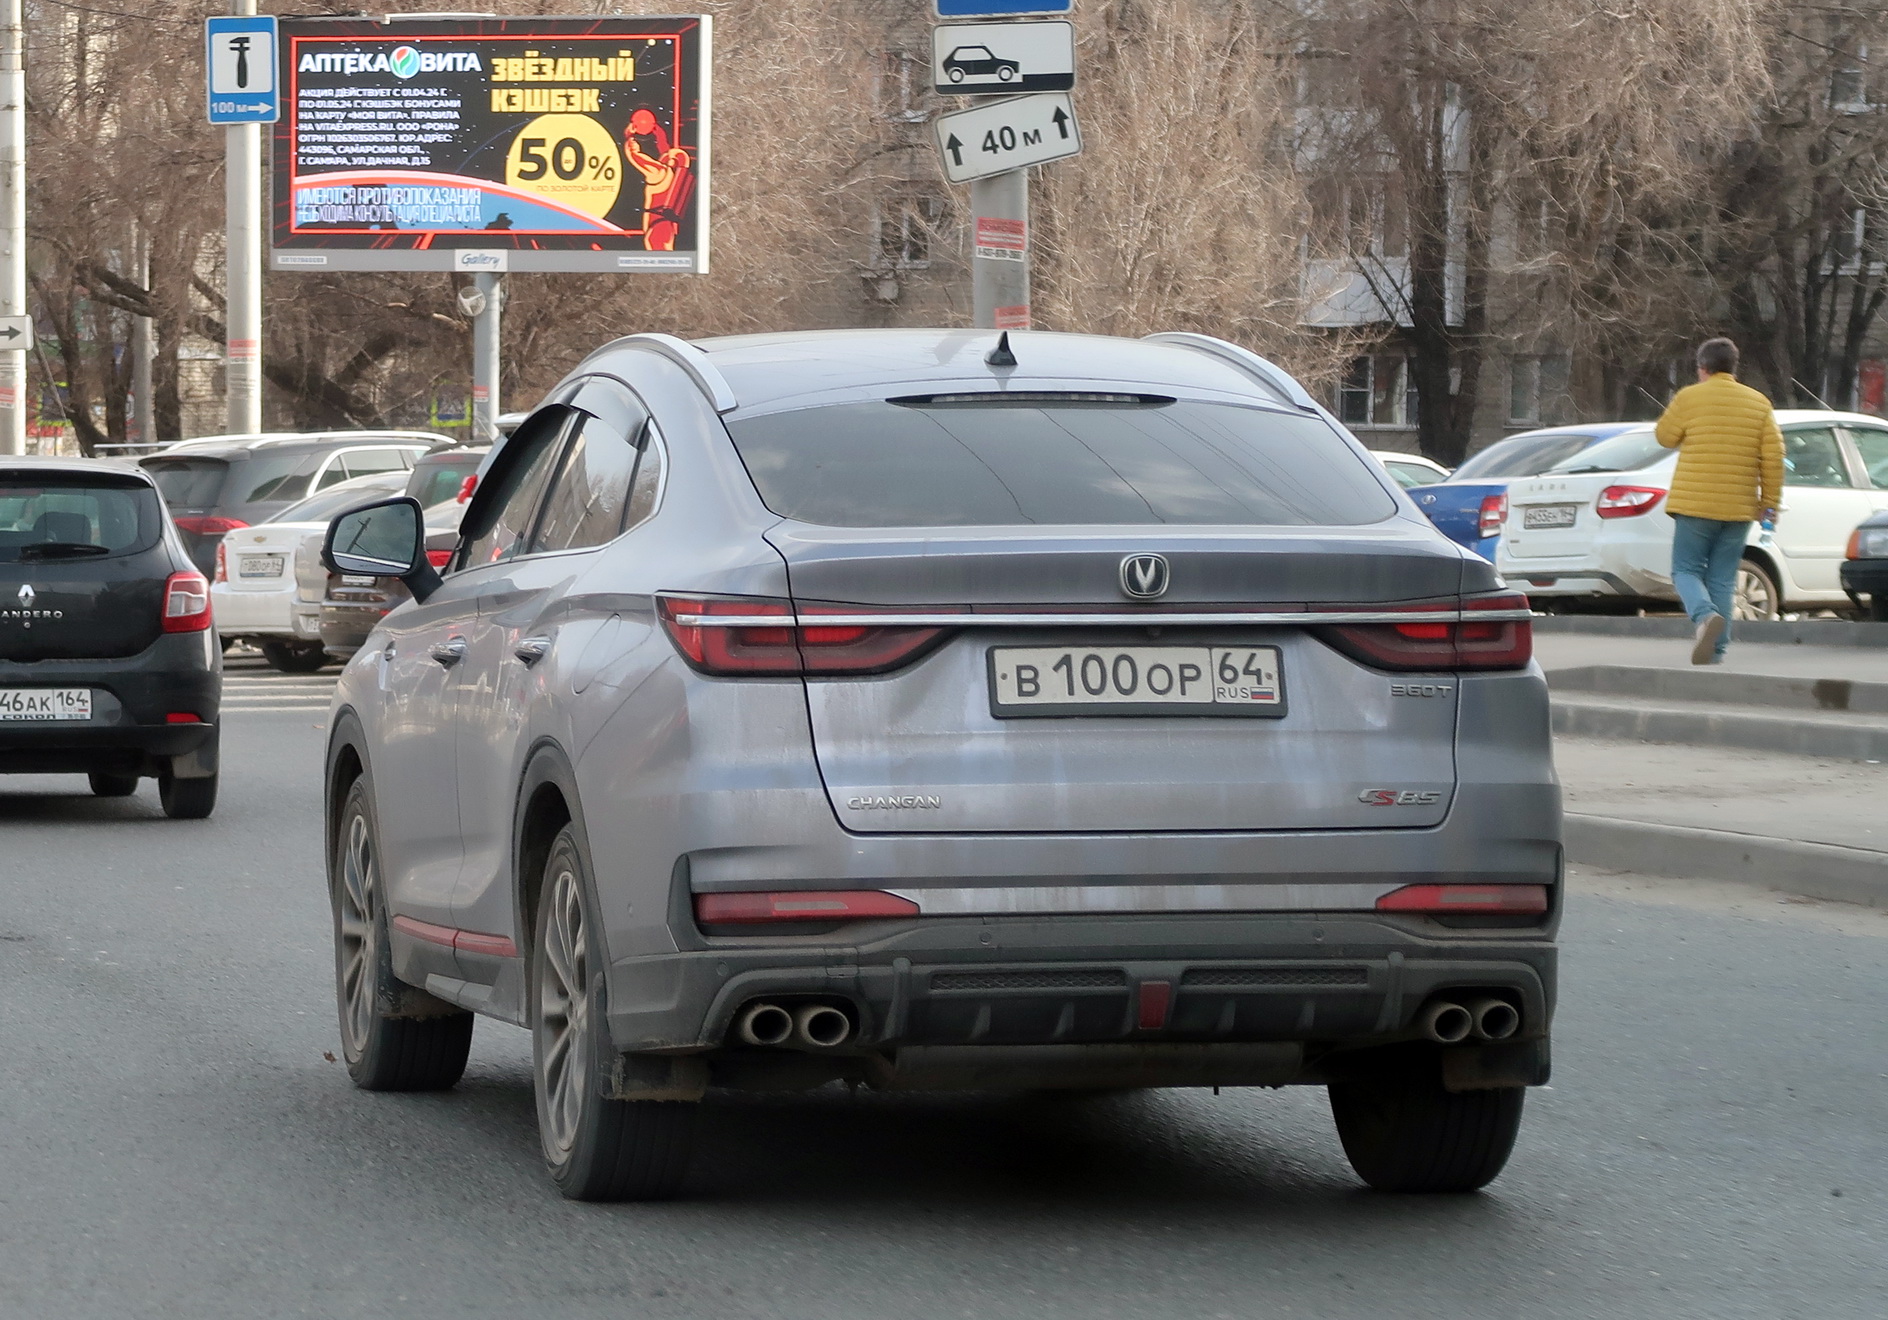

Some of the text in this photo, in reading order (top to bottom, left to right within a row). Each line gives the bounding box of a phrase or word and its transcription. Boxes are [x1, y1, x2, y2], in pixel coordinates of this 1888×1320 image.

[298, 52, 482, 73] АПТЕКА ВИТА
[491, 50, 635, 82] ЗВЁЗДНЫЙ
[298, 88, 334, 98] АКЦИЯ
[335, 87, 392, 98] ДЕЙСТВУЕТ
[392, 88, 401, 97] С
[491, 88, 600, 112] КЭШБЭК
[212, 102, 235, 113] 100
[298, 100, 314, 108] ПО
[362, 100, 404, 108] КЭШБЭК
[404, 100, 461, 108] БОНУСАМИ
[298, 112, 314, 120] НА
[314, 112, 346, 120] КАРТУ
[411, 112, 460, 120] ПРАВИЛА
[298, 134, 326, 142] ОГРН
[982, 126, 1016, 154] 40
[336, 145, 397, 154] САМАРСКАЯ
[517, 137, 616, 182] 50%
[298, 188, 481, 205] ИМЕЮТСЯ ПРОТИВОПОКАЗАНИЯ
[462, 253, 500, 269] Gallery
[1218, 652, 1264, 686] 64
[56, 691, 87, 706] 164
[1216, 686, 1250, 698] RUS
[1391, 684, 1452, 698] 360T
[847, 795, 942, 810] CHANGAN
[1358, 788, 1442, 806] CS85
